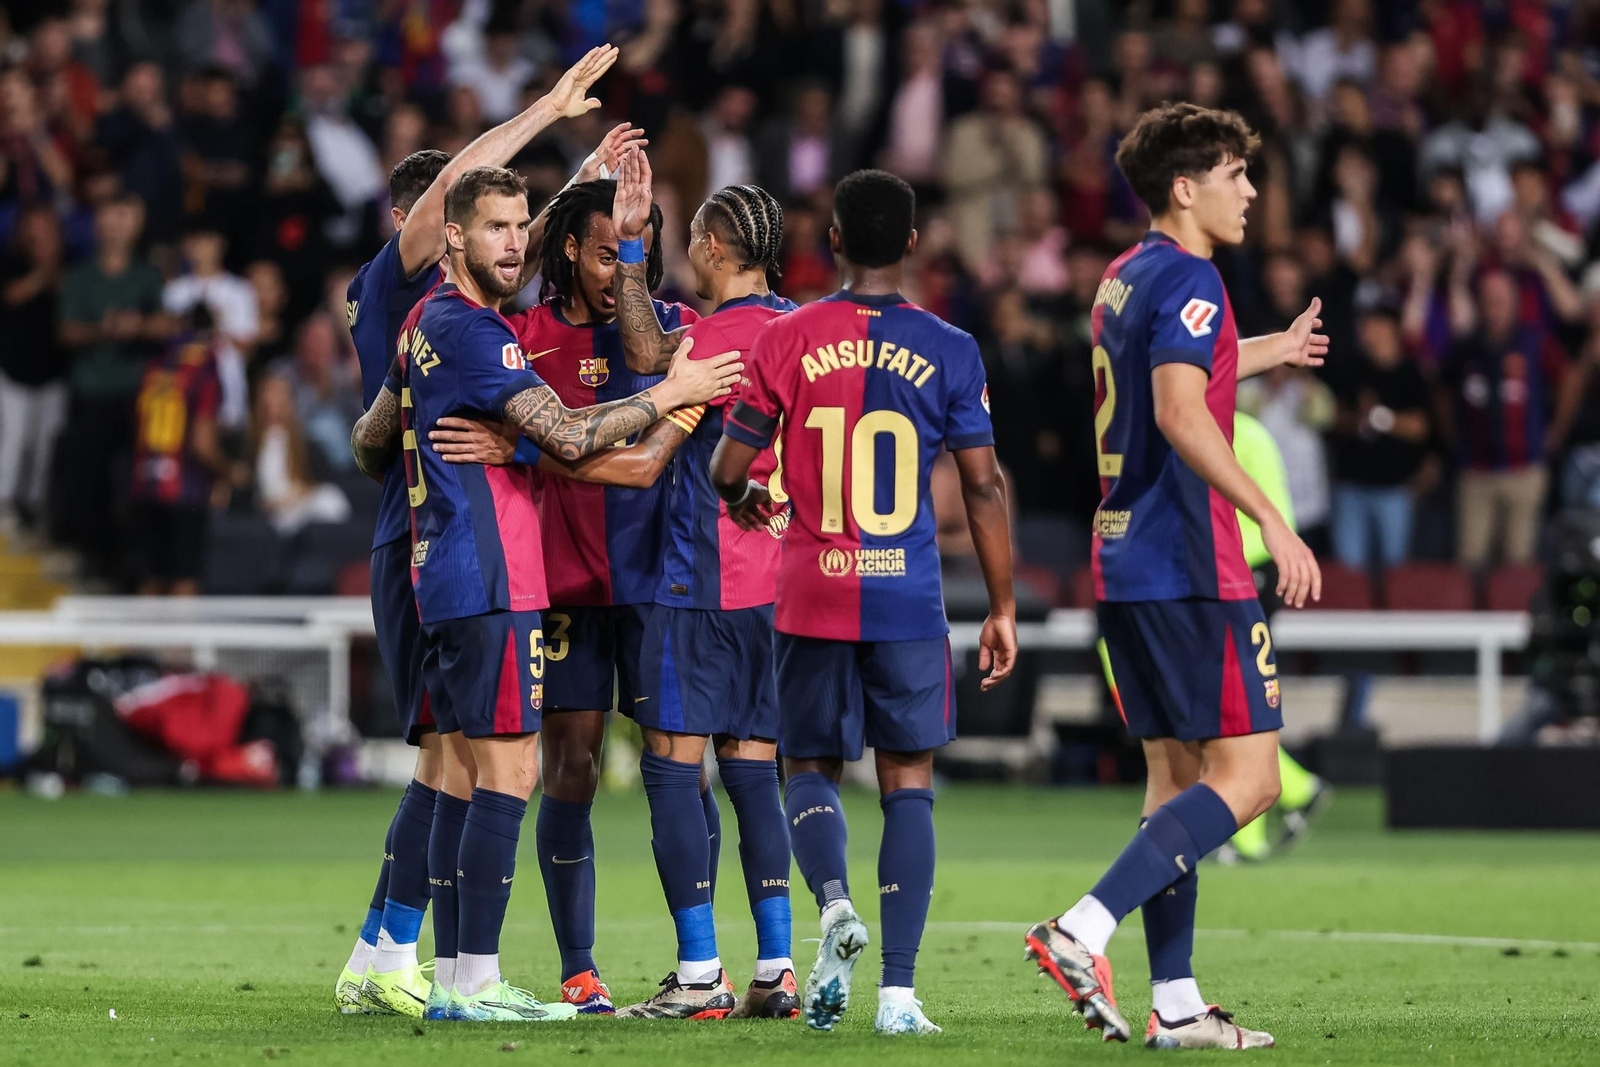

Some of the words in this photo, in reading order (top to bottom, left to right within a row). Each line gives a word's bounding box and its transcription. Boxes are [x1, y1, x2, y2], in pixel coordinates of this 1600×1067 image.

[801, 339, 874, 383] ANSU
[876, 341, 936, 389] FATI
[1092, 344, 1123, 476] 2
[803, 406, 919, 536] 10
[854, 548, 905, 560] UNHCR
[854, 560, 906, 571] ACNUR
[529, 629, 544, 679] 5
[1251, 621, 1277, 677] 2
